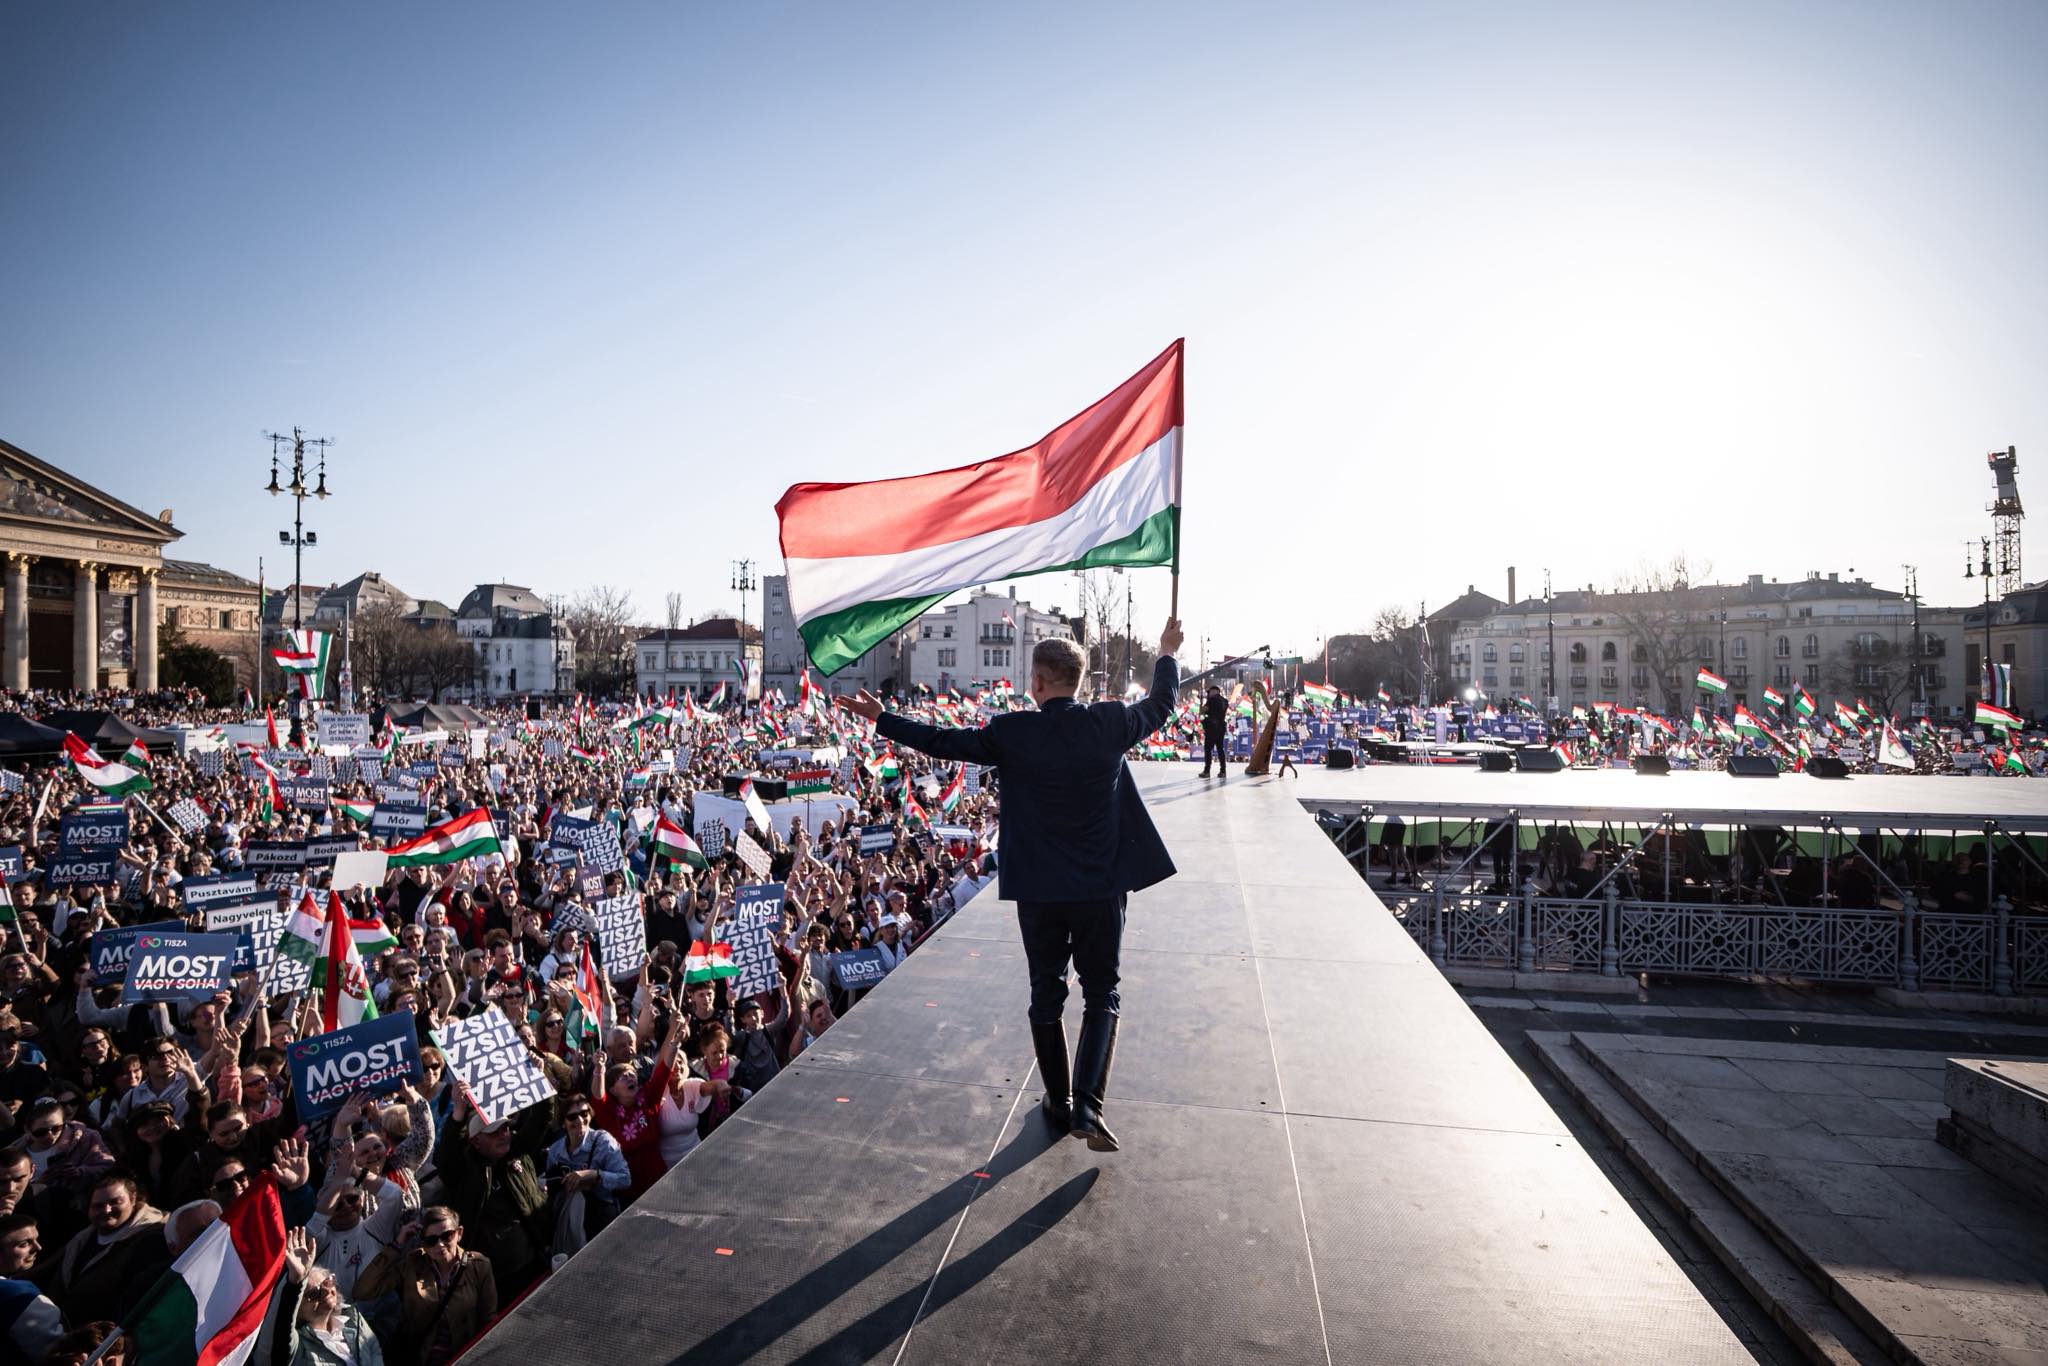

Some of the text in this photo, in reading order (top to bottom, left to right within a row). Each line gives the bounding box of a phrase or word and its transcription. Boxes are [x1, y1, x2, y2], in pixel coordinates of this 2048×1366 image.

[296, 787, 325, 799] MOST
[795, 779, 824, 789] MENDE
[387, 816, 411, 825] Mór
[578, 821, 612, 841] TISZA
[66, 826, 124, 840] MOST
[555, 825, 580, 838] MO
[581, 826, 616, 850] TISZA
[255, 852, 297, 861] Pákozd
[585, 835, 621, 860] TISZA
[52, 863, 111, 877] MOST
[190, 886, 252, 898] Pusztavám
[583, 876, 602, 891] MOST
[213, 908, 271, 923] Nagyveleg
[596, 894, 642, 916] TISZA
[740, 899, 781, 919] MOST
[598, 908, 643, 931] TISZA
[715, 914, 768, 939] TISZA
[600, 922, 645, 947] TISZA
[601, 938, 646, 962] TISZA
[136, 955, 226, 978] MOST
[840, 960, 881, 977] MOST
[135, 978, 221, 991] VAGY SOHA!
[431, 1010, 511, 1047] TISZA
[323, 1034, 353, 1049] TISZA
[442, 1025, 522, 1067] TISZA
[306, 1036, 407, 1093] MOST
[454, 1043, 531, 1085] TISZA
[307, 1061, 412, 1105] VAGY SOHA!
[467, 1066, 546, 1105] TISZA
[479, 1077, 558, 1124] TISZA
